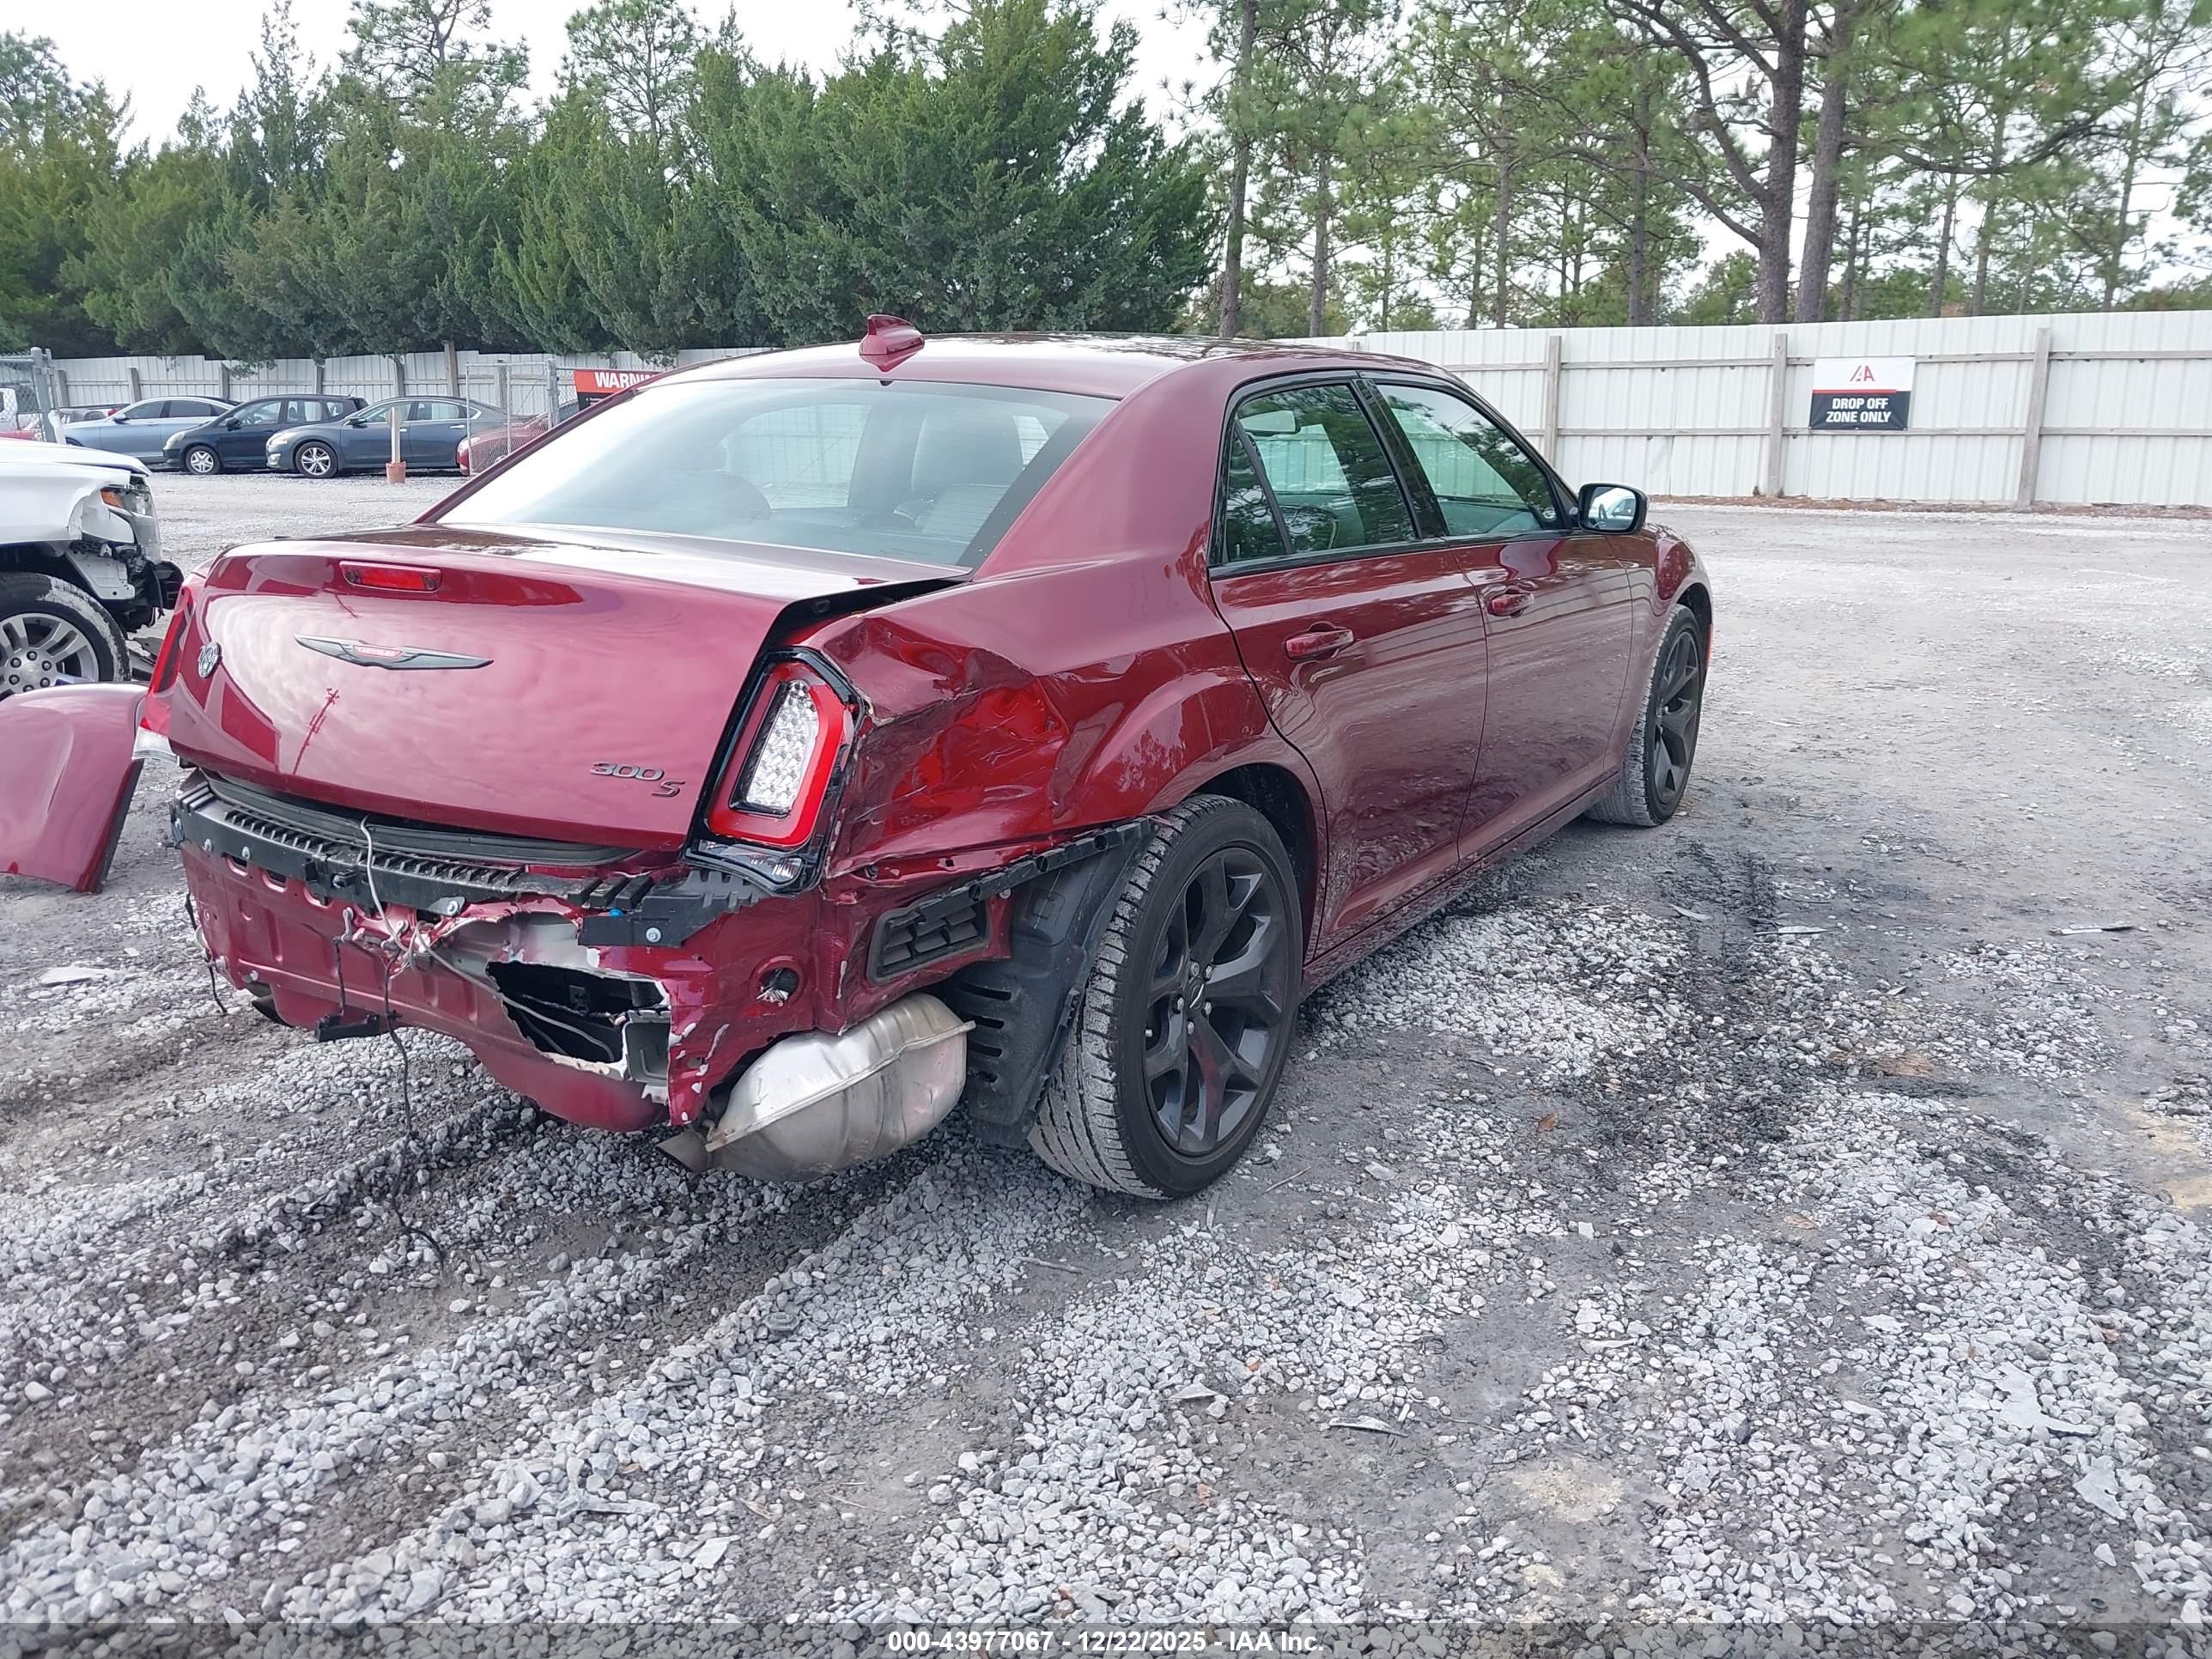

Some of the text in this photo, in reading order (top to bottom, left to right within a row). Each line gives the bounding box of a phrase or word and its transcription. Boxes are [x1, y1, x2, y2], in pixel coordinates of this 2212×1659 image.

[594, 371, 655, 389] WARNI
[1832, 398, 1889, 410] DROP OFF
[1826, 411, 1892, 422] ZONE ONLY
